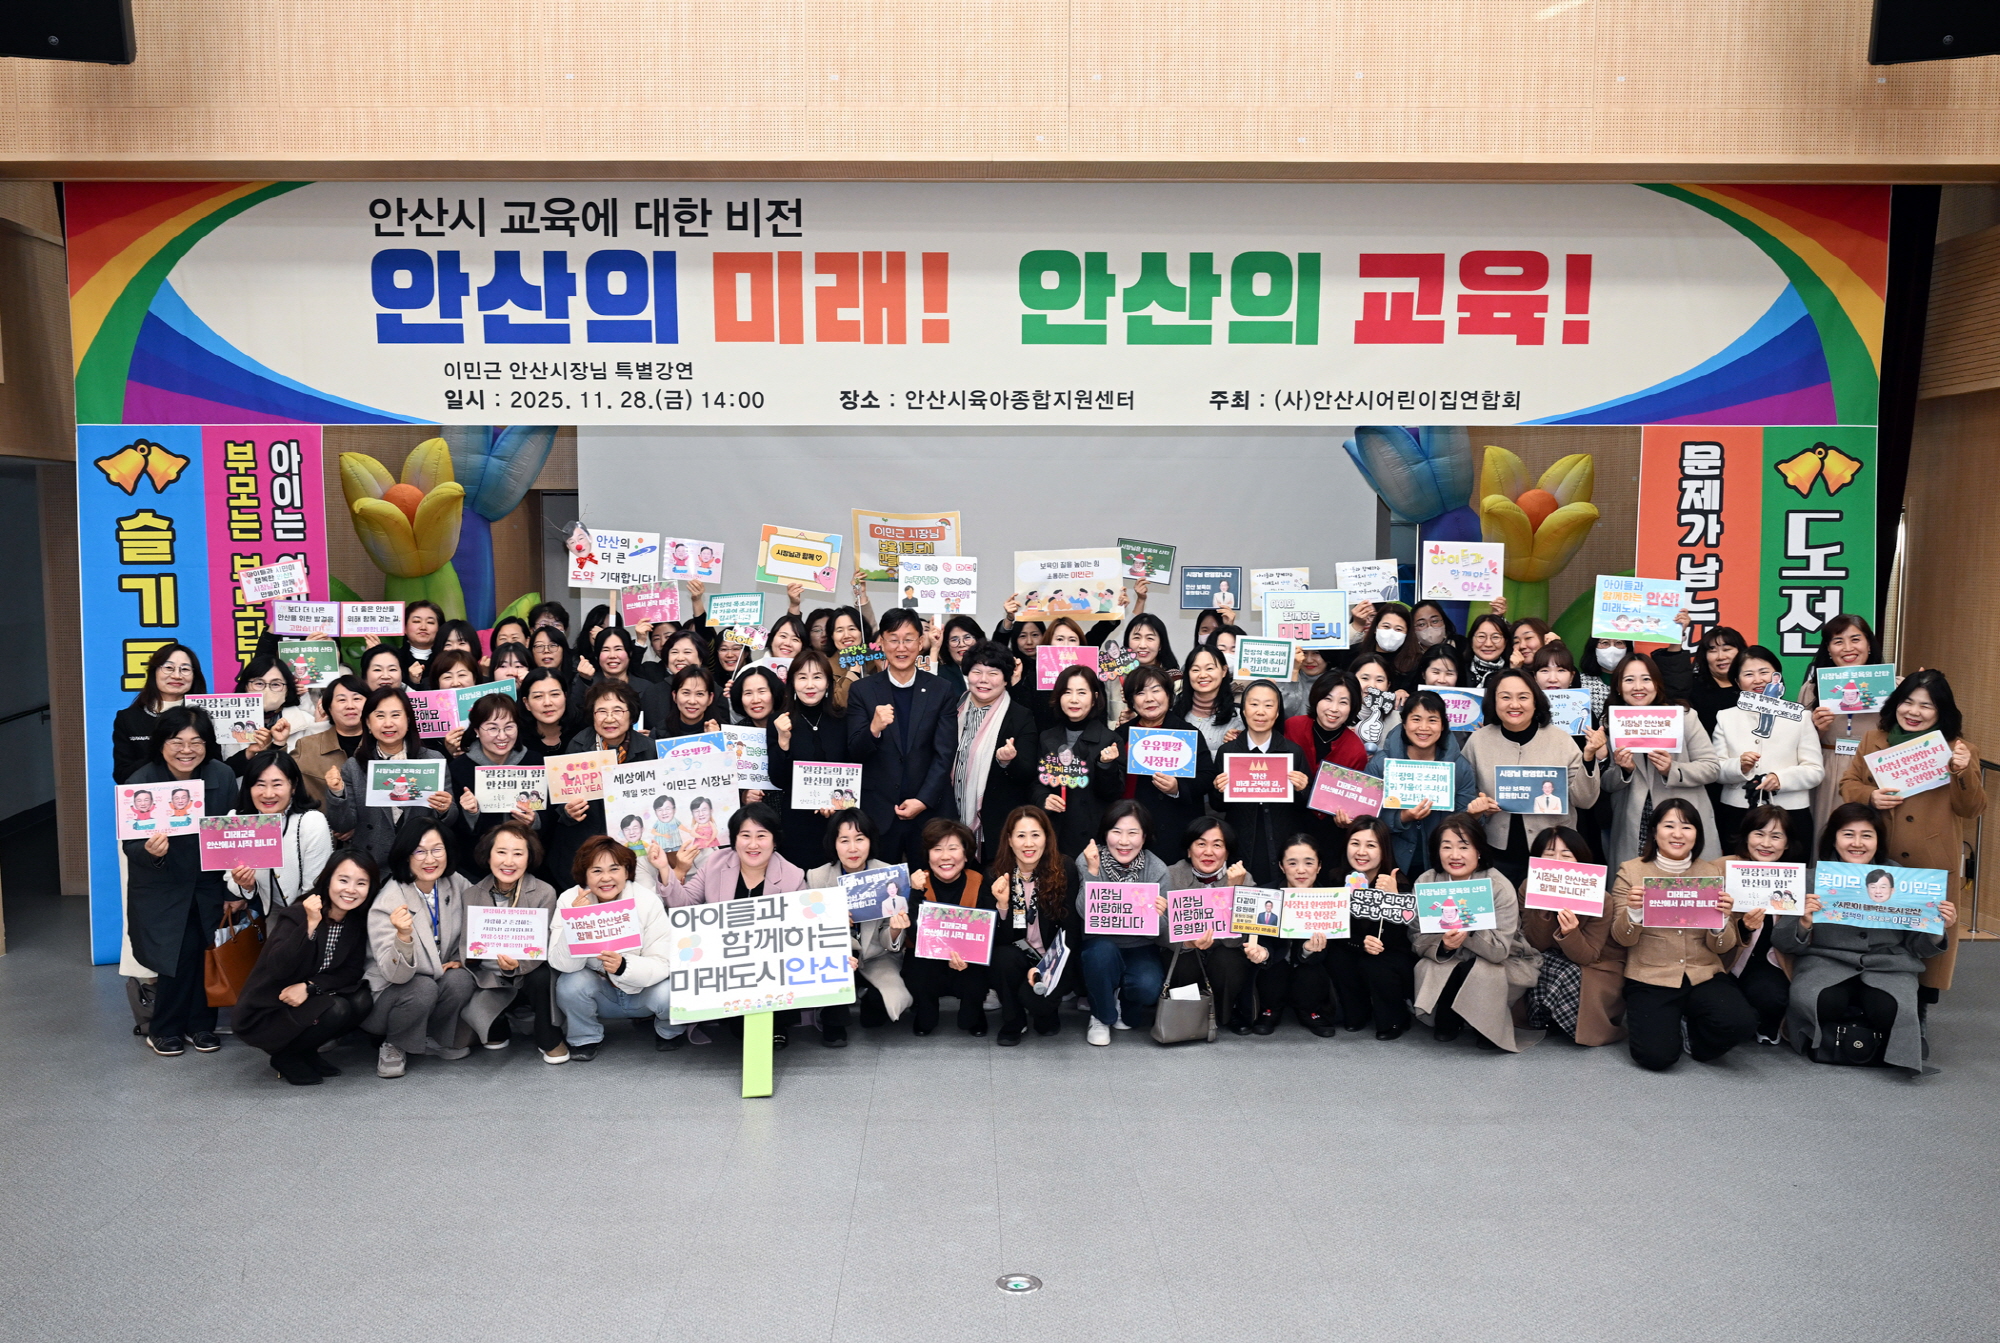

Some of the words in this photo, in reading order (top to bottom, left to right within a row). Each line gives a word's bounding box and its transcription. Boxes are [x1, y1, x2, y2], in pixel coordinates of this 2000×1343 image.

[369, 198, 486, 237] 안산시
[501, 198, 619, 238] 교육에
[637, 198, 713, 238] 대한
[727, 198, 803, 239] 비전
[371, 249, 678, 345] 안산의
[714, 251, 950, 345] 미래!
[1018, 249, 1321, 346] 안산의
[1354, 250, 1593, 346] 교육!
[444, 361, 502, 382] 이민근
[508, 361, 607, 382] 안산시장님
[614, 361, 694, 382] 특별강연
[444, 390, 485, 411] 일시
[510, 391, 570, 411] 2025.
[579, 391, 611, 411] 11.
[619, 389, 693, 413] 28.(금)
[701, 391, 765, 411] 14:00
[839, 389, 880, 411] 장소
[905, 389, 1135, 412] 안산시육아종합지원센터
[1209, 389, 1250, 411] 주최
[1274, 389, 1522, 412] (사)안산시어린이집연합회
[225, 440, 262, 541] 부모는
[270, 440, 306, 541] 아이는
[1678, 441, 1724, 547] 문제가
[874, 526, 905, 539] 이민근
[908, 528, 940, 539] 시장님
[596, 535, 630, 549] 안산의
[878, 539, 898, 554] 보육
[915, 541, 935, 554] 도시
[601, 552, 612, 563] 더
[616, 552, 626, 564] 큰
[776, 549, 801, 558] 시장님과
[802, 552, 815, 561] 함께
[1040, 562, 1059, 570] 보육의
[571, 570, 595, 583] 도약
[600, 572, 656, 583] 기대합니다!
[1047, 572, 1069, 580] 소통하는
[1604, 579, 1644, 591] 아이들과
[1270, 599, 1295, 609] 아이와
[1602, 591, 1643, 602] 함께하는
[1646, 592, 1680, 607] 안산!
[1282, 610, 1320, 622] 함께하는
[1277, 622, 1341, 642] 미래도시
[1821, 671, 1850, 681] 시장님은
[1851, 670, 1873, 679] 보육의
[1874, 669, 1890, 678] 산타
[1773, 710, 1801, 719] FOREVER
[1644, 719, 1671, 728] 안산보육
[1624, 728, 1638, 736] 함께
[1141, 740, 1183, 752] 우유빛깔
[1046, 755, 1059, 763] 우리
[1142, 756, 1180, 768] 시장님!
[1875, 759, 1901, 774] 시장님
[1900, 744, 1945, 766] 환영합니다
[481, 769, 527, 778] "원장들의
[530, 769, 545, 778] 힘!
[846, 767, 858, 776] 힘!
[1045, 764, 1081, 774] 함께라서
[1522, 770, 1558, 778] 환영합니다
[1891, 768, 1909, 780] 보육
[1909, 758, 1938, 773] 현장은
[613, 770, 656, 785] 세상에서
[803, 776, 832, 786] 안산의
[1905, 765, 1950, 787] 응원합니다
[486, 780, 517, 789] 안산의
[521, 780, 540, 789] 힘!"
[561, 787, 582, 795] NEW
[622, 788, 638, 798] 제일
[640, 786, 656, 797] 멋진
[223, 829, 256, 839] 미래교육
[206, 840, 235, 849] 안산에서
[237, 839, 252, 848] 시작
[254, 838, 277, 848] 됩니다
[1532, 870, 1562, 884] "시장님!
[1565, 875, 1598, 887] 안산보육
[1783, 868, 1797, 878] 힘!
[1539, 882, 1556, 893] 함께
[1741, 879, 1771, 888] 안산의
[1818, 872, 1862, 889] 꽃미모
[1900, 880, 1942, 896] 이민근
[1089, 889, 1122, 901] 시장님
[1419, 887, 1447, 897] 시장님은
[1448, 886, 1470, 895] 보육의
[1471, 885, 1487, 893] 산타
[1666, 890, 1698, 898] 미래교육
[1172, 895, 1204, 908] 시장님
[1284, 900, 1309, 909] 시장님
[1310, 900, 1347, 909] 환영합니다
[1354, 890, 1383, 904] 따뜻한
[1385, 895, 1415, 909] 리더십
[1649, 900, 1678, 908] 안산에서
[670, 895, 789, 933] 아이들과
[1089, 903, 1133, 914] 사랑해요
[1351, 902, 1380, 917] 확고한
[1382, 908, 1402, 921] 비전
[1172, 908, 1215, 922] 사랑해요
[1295, 911, 1311, 920] 보육
[1313, 910, 1337, 920] 현장은
[566, 919, 596, 930] "시장님!
[598, 913, 631, 927] 안산보육
[940, 921, 968, 930] 미래교육
[1089, 916, 1144, 929] 응원합니다
[1173, 920, 1227, 935] 응원합니다
[1304, 921, 1343, 930] 응원합니다
[576, 931, 593, 941] 함께
[721, 923, 849, 959] 함께하는
[671, 954, 850, 996] 미래도시안산
